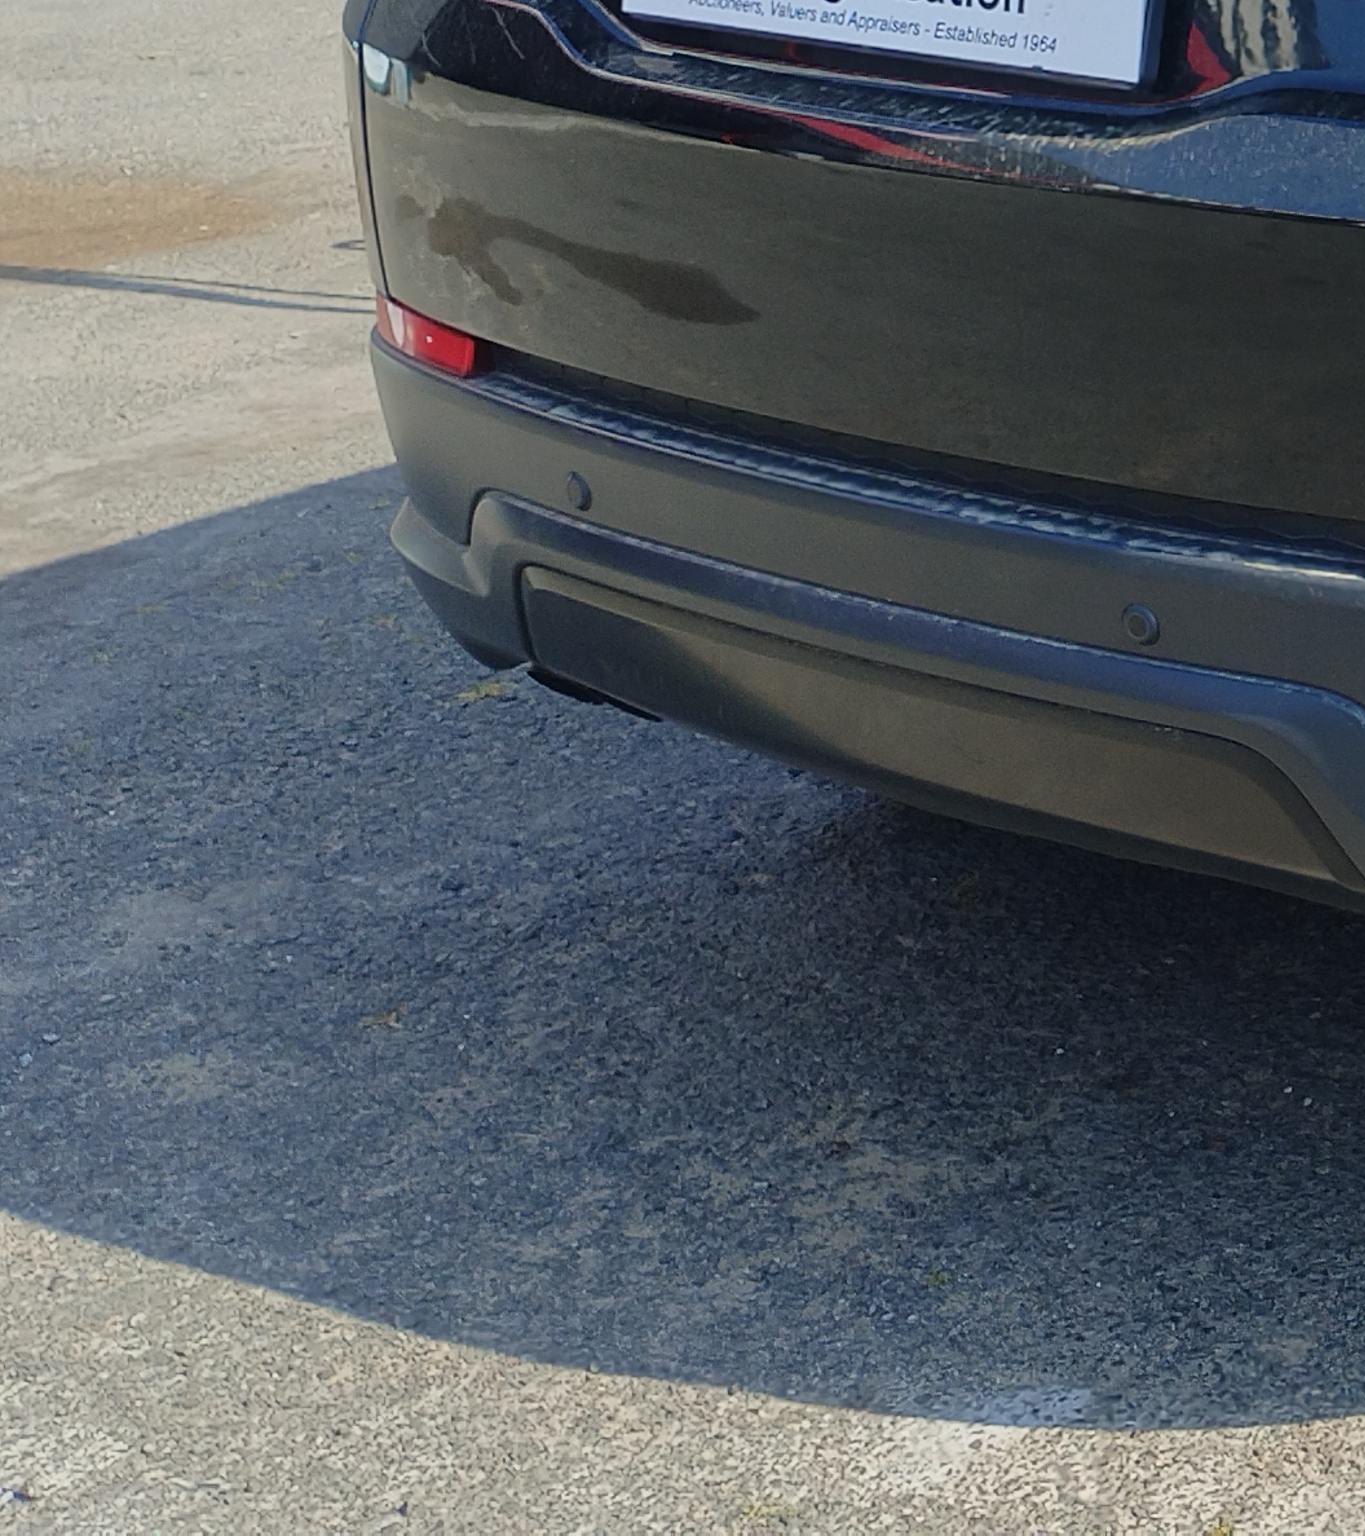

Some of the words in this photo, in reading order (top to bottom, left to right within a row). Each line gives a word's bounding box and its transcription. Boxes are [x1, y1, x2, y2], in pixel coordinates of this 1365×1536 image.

[770, 1, 816, 23] Valuers
[821, 11, 845, 26] and
[847, 11, 921, 36] Appraisers
[934, 22, 1017, 49] Established
[1023, 35, 1057, 54] 1964
